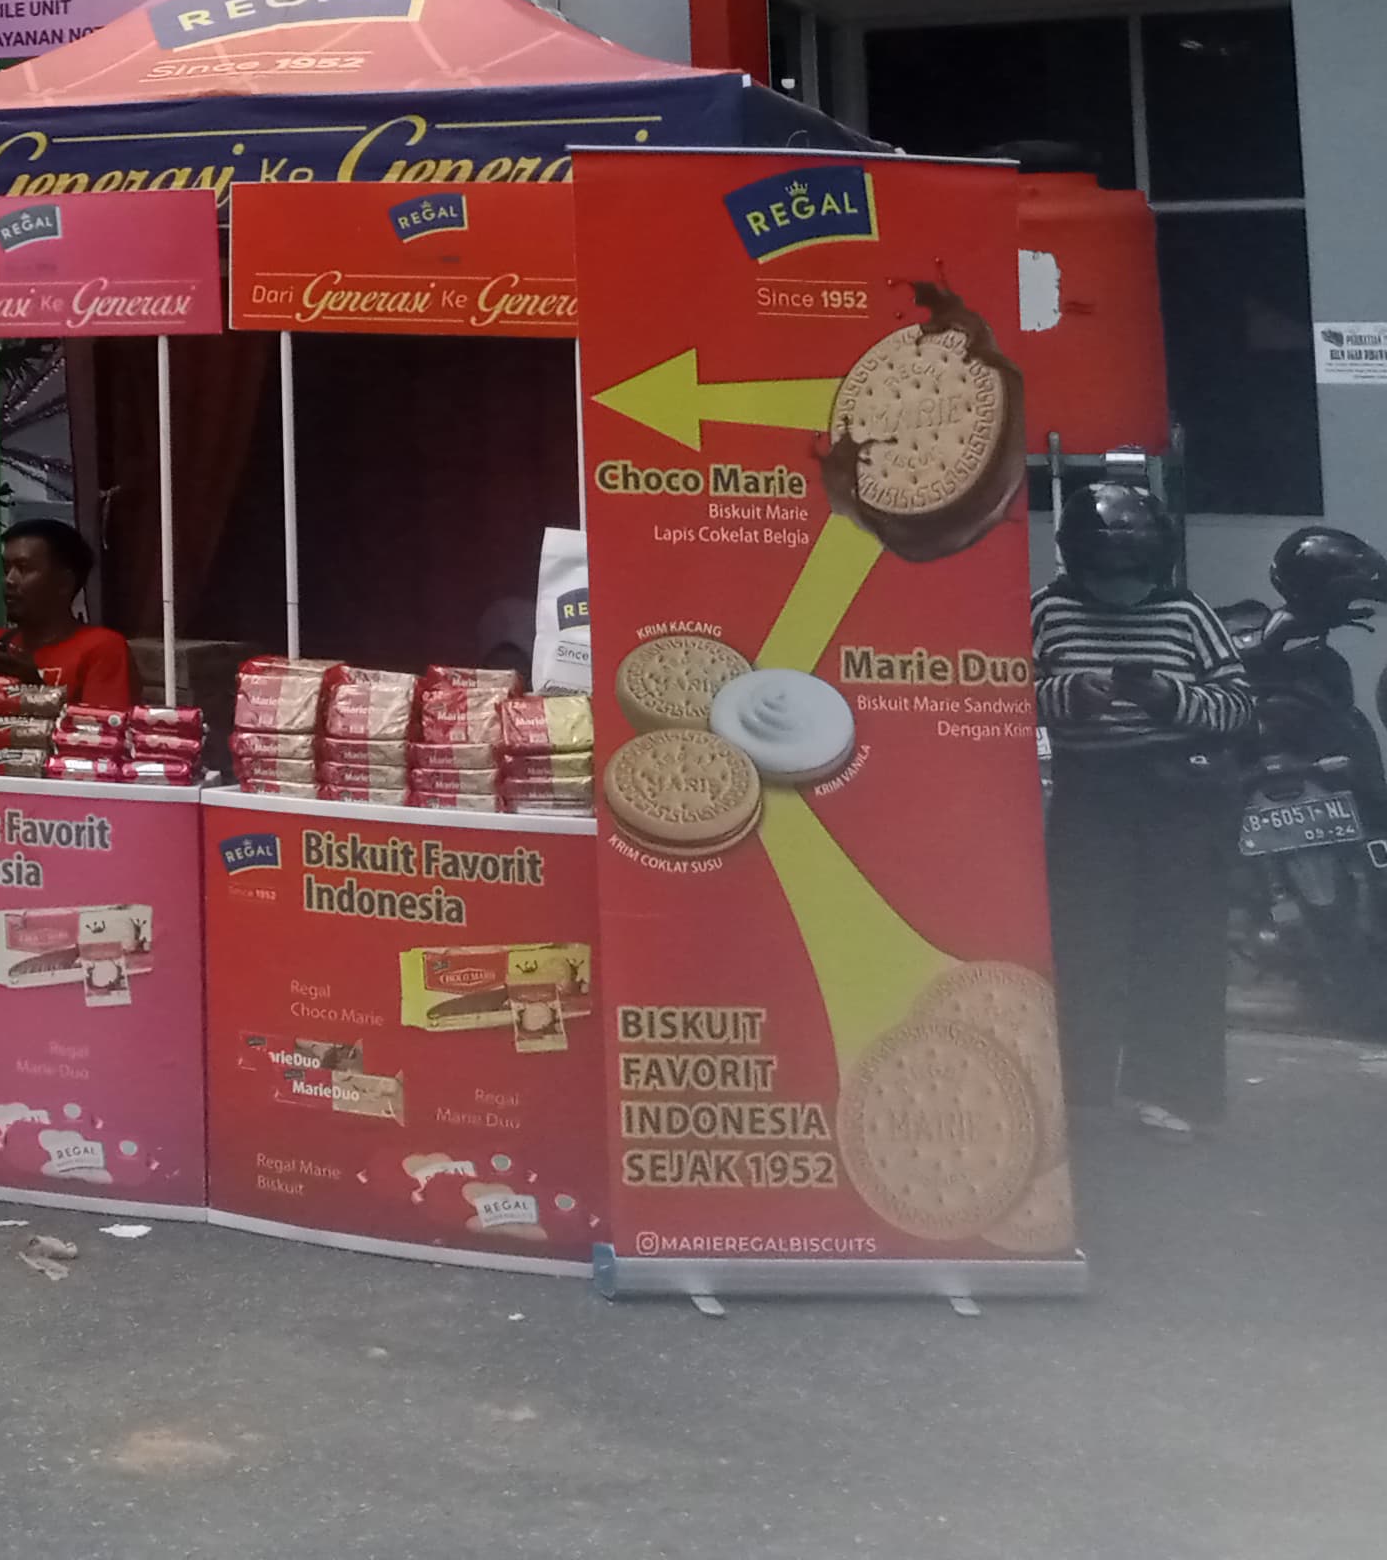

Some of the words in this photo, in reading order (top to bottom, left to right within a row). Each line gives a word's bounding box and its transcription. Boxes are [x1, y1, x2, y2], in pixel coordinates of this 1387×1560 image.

[29, 0, 73, 17] UNIT
[147, 59, 260, 79] Since
[275, 56, 366, 71] 1952
[398, 204, 459, 230] REGAL
[746, 191, 859, 237] REGAL
[0, 216, 54, 241] REGAL
[41, 294, 64, 312] Ke
[67, 277, 196, 328] Generasi
[252, 284, 293, 304] Dari
[295, 270, 436, 323] Generasi
[442, 290, 468, 308] Ke
[757, 287, 814, 308] Since
[821, 290, 868, 309] 1952
[595, 460, 704, 495] Choco
[709, 464, 807, 498] Marie
[709, 503, 762, 520] Biskuit
[766, 505, 809, 521] Marie
[654, 525, 695, 545] Lapis
[698, 526, 759, 543] Cokelat
[763, 529, 809, 548] Belgia
[636, 622, 668, 640] KRIM
[670, 621, 723, 638] KACANG
[557, 646, 589, 661] Since
[840, 646, 952, 685] Marie
[957, 649, 1030, 687] Duo
[857, 695, 909, 712] Biskuit
[914, 696, 960, 713] Marie
[964, 697, 1032, 715] Sandwich
[938, 720, 1000, 740] Dengan
[1004, 722, 1033, 738] Krim
[814, 776, 844, 797] KRIM
[841, 743, 872, 783] VANILA
[5, 808, 111, 850] Favorit
[225, 844, 274, 863] REGAL
[303, 830, 416, 876] Biskuit
[422, 840, 545, 886] Favorit
[608, 833, 639, 861] KRIM
[640, 853, 688, 874] COKLAT
[691, 856, 723, 874] SUSU
[303, 874, 467, 927] Indonesia
[290, 980, 331, 1000] Regal
[290, 1002, 338, 1021] Choco
[341, 1010, 386, 1027] Marie
[618, 1008, 765, 1043] BISKUIT
[620, 1055, 776, 1089] FAVORIT
[292, 1080, 360, 1102] MarieDuo
[475, 1088, 520, 1108] Regal
[485, 1113, 521, 1129] Duo
[622, 1103, 829, 1138] INDONESIA
[56, 1146, 96, 1160] REGAL
[257, 1152, 296, 1173] Regal
[299, 1160, 342, 1180] Marie
[624, 1151, 742, 1186] SEJAK
[747, 1152, 837, 1187] 1952
[257, 1175, 304, 1195] Biskuit
[484, 1199, 530, 1215] REGAL
[660, 1236, 877, 1253] MARIEREGALBISCUITS
